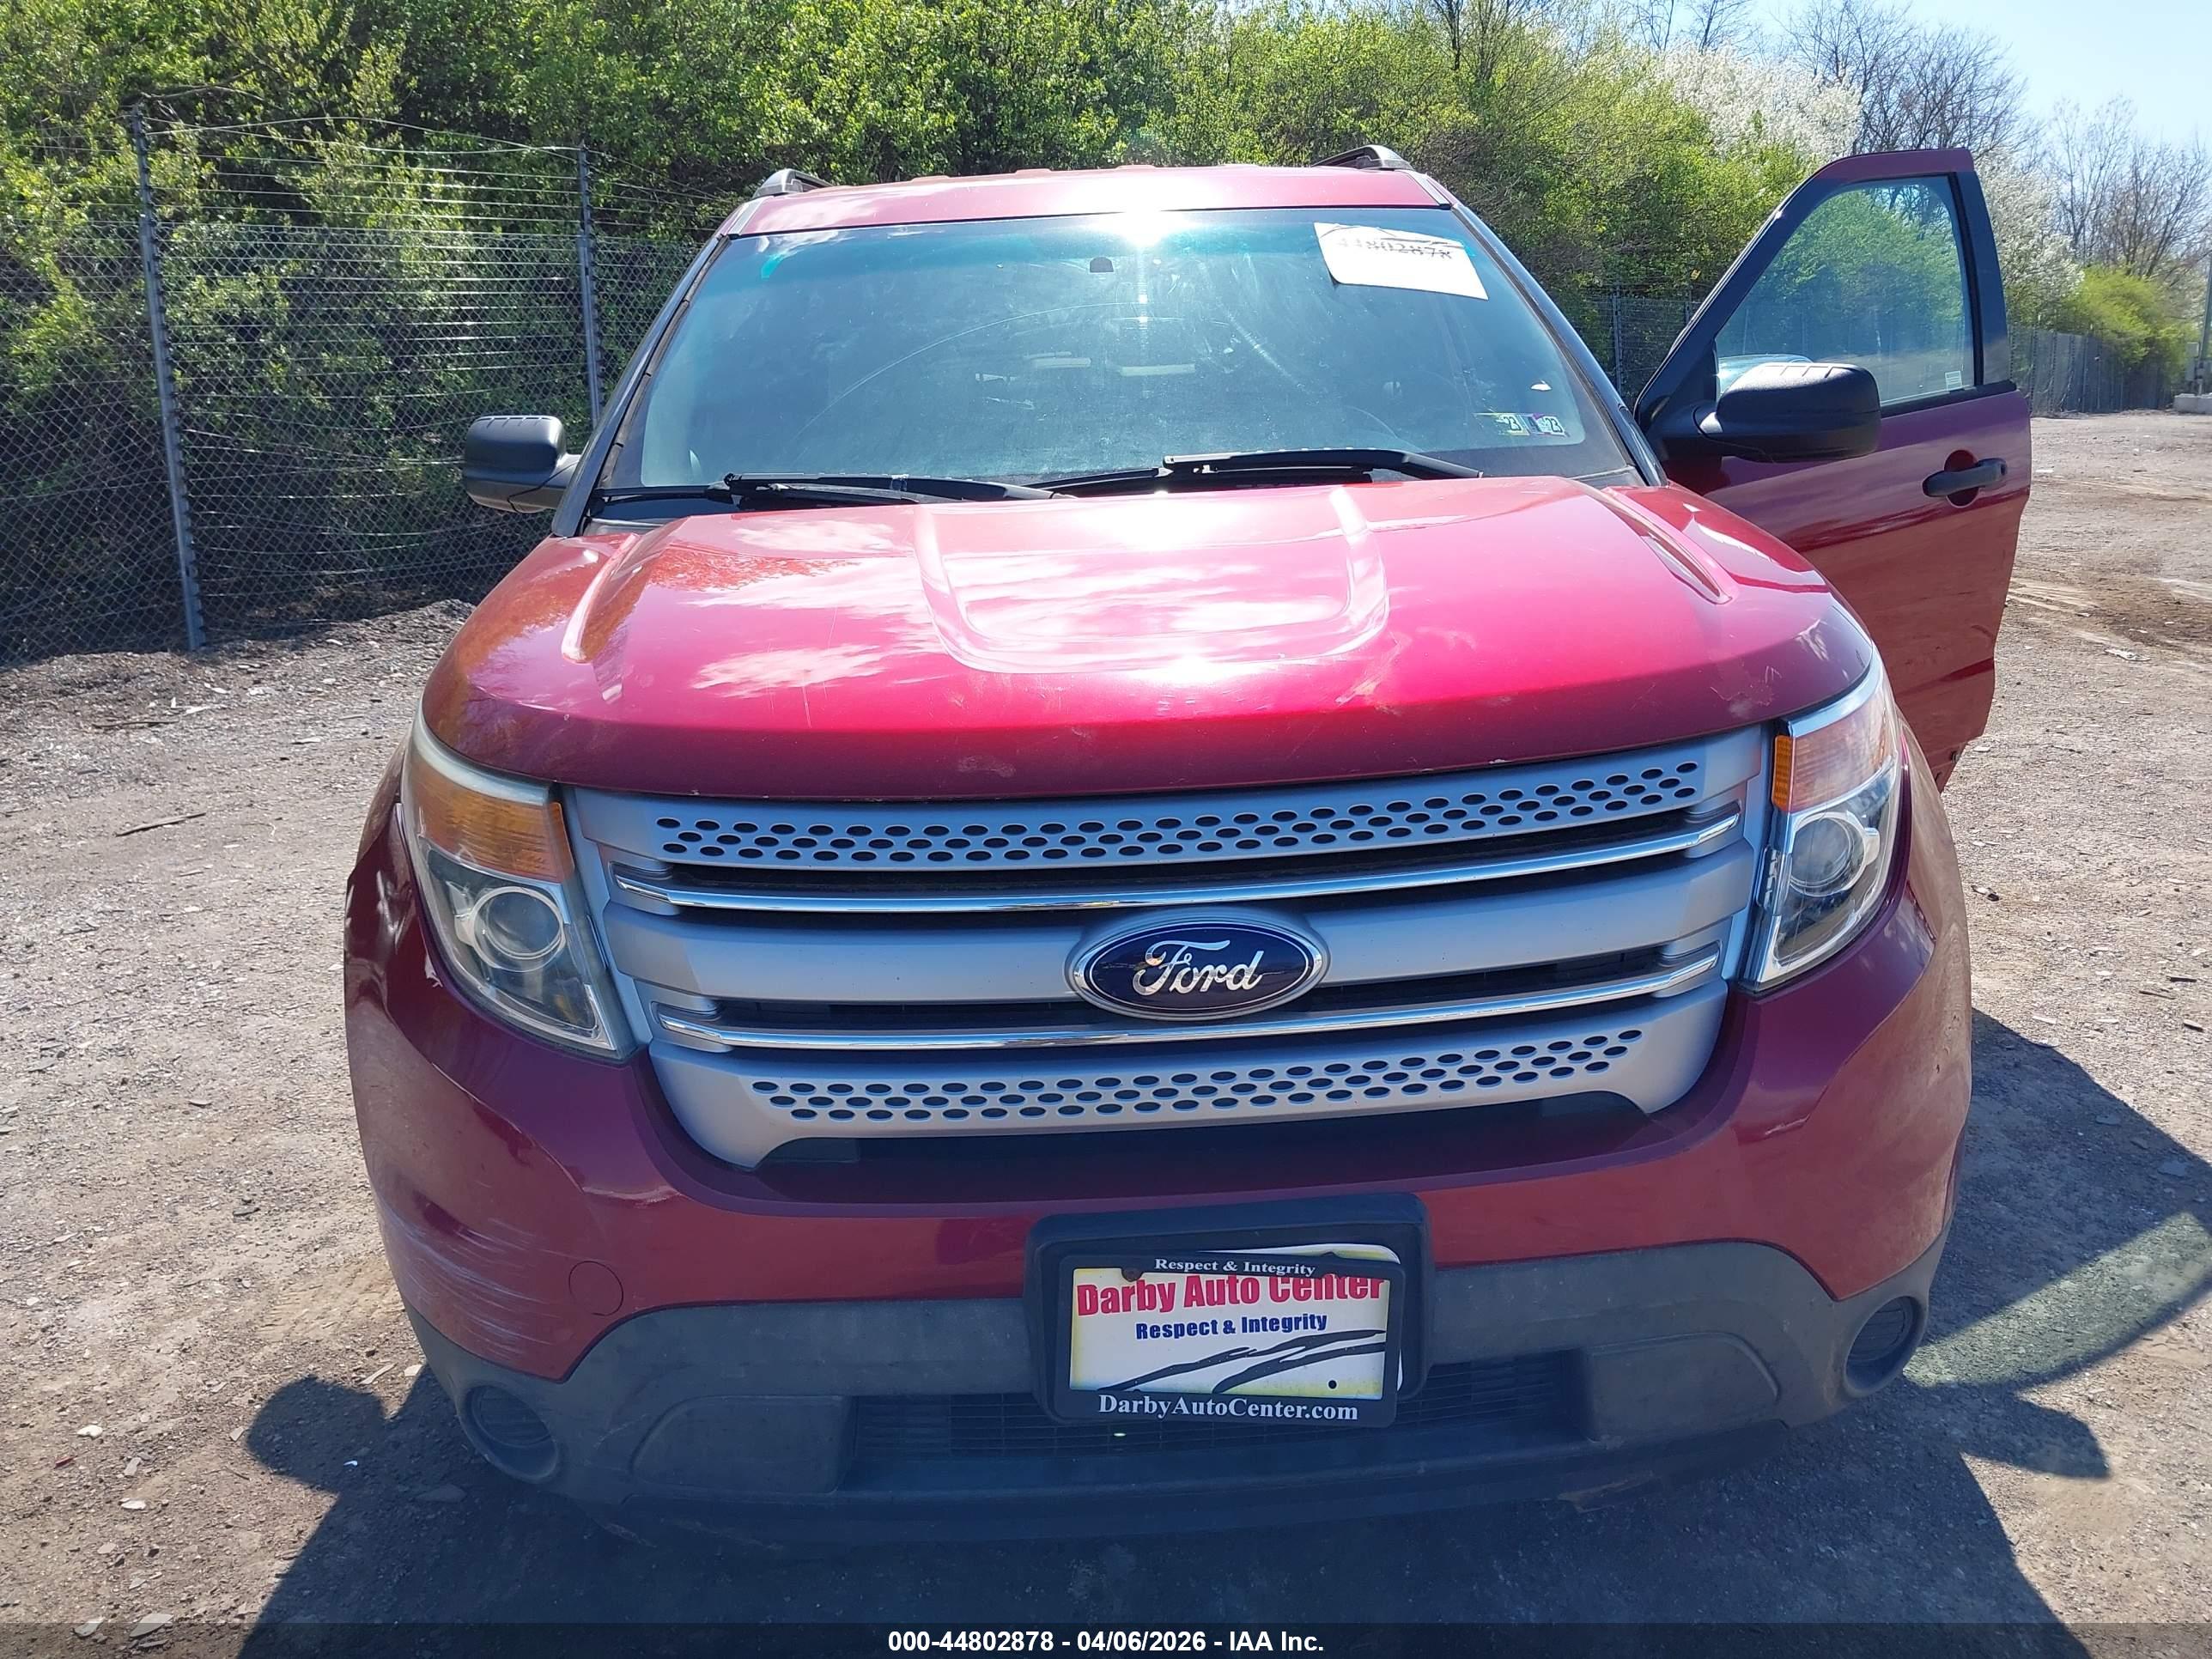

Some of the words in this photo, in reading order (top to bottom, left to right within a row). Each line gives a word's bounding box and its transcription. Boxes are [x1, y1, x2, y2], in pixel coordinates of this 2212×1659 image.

[1133, 940, 1264, 996] Ford
[1154, 1258, 1218, 1273] Respect
[1222, 1261, 1238, 1272] &
[1243, 1261, 1316, 1277] Integrity
[1077, 1279, 1176, 1316] Darby
[1183, 1274, 1261, 1308] Auto
[1268, 1274, 1385, 1304] Center
[1135, 1320, 1218, 1340] Respect
[1223, 1319, 1236, 1334] &
[1242, 1313, 1328, 1333] Integrity
[1098, 1394, 1358, 1420] DarbyAutoCenter.com
